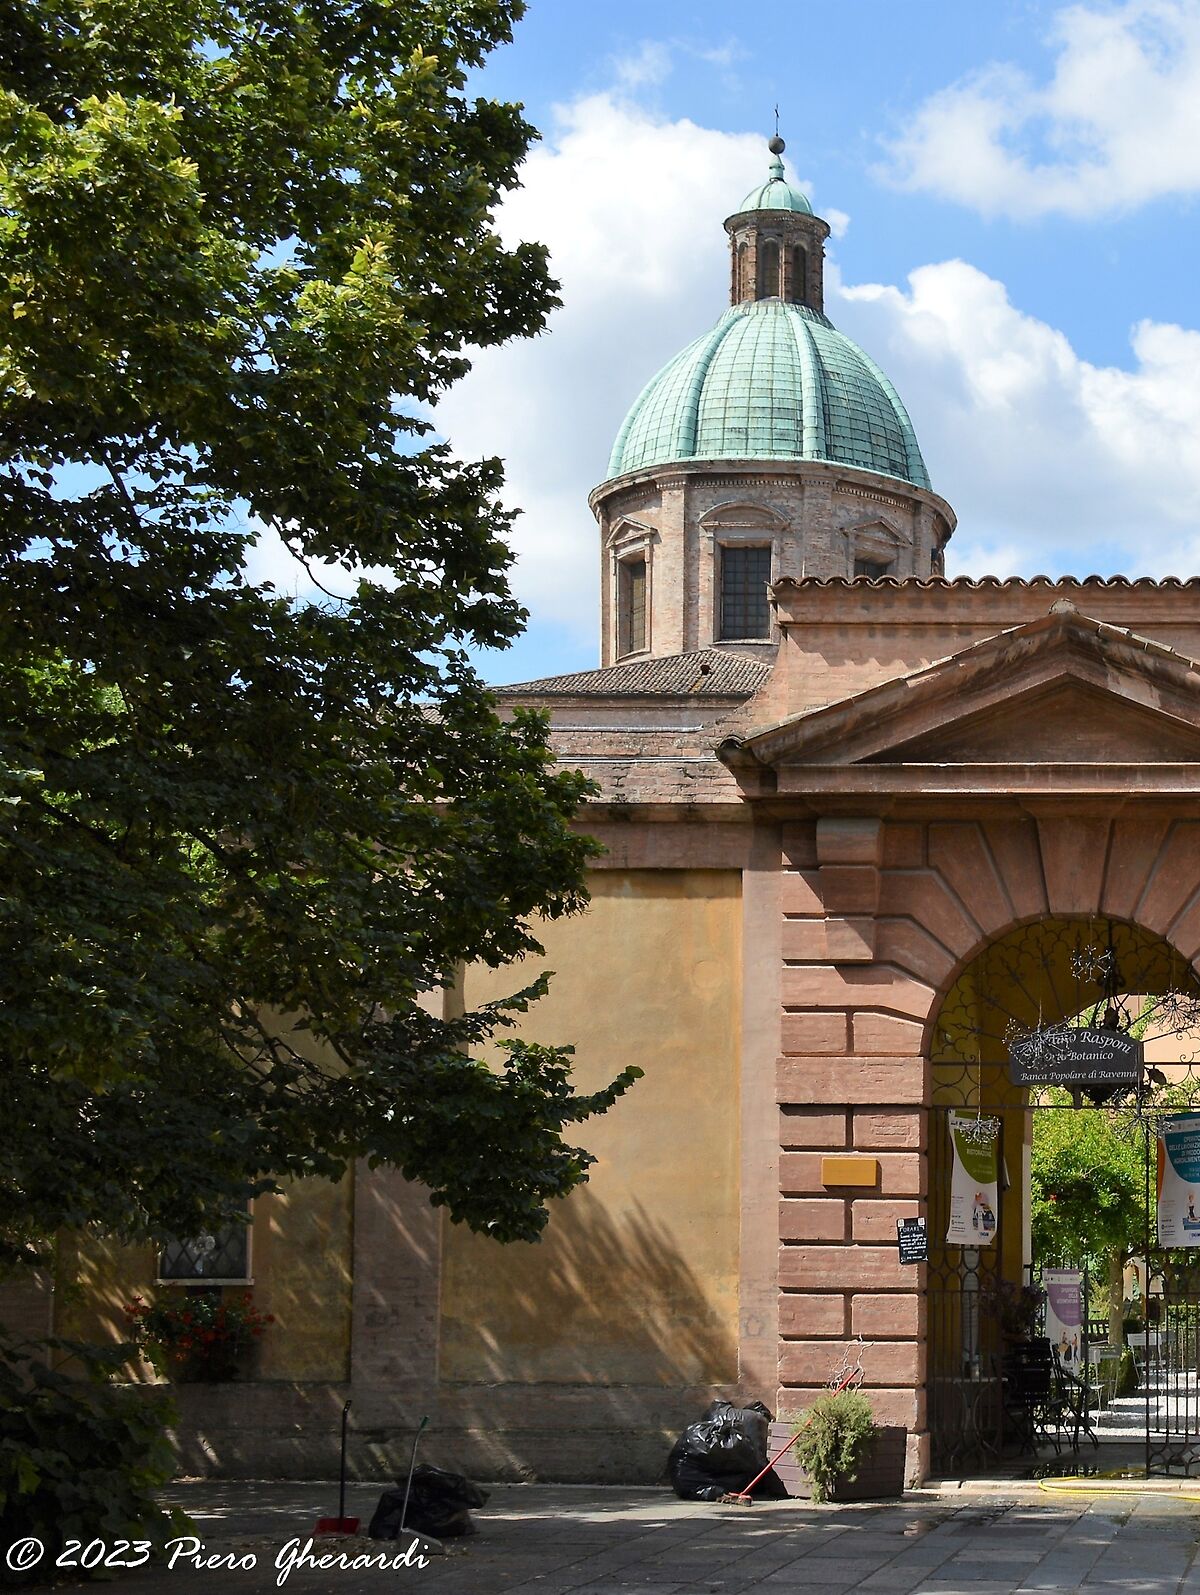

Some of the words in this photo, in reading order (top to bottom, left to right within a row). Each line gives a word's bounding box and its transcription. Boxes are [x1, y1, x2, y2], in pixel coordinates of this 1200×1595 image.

[1080, 1031, 1135, 1054] Rasponi
[1069, 1051, 1114, 1061] Botanico
[1020, 1072, 1048, 1081] Banca
[1049, 1070, 1087, 1082] Popolare
[1088, 1069, 1097, 1079] di
[1099, 1069, 1138, 1079] Ravenna
